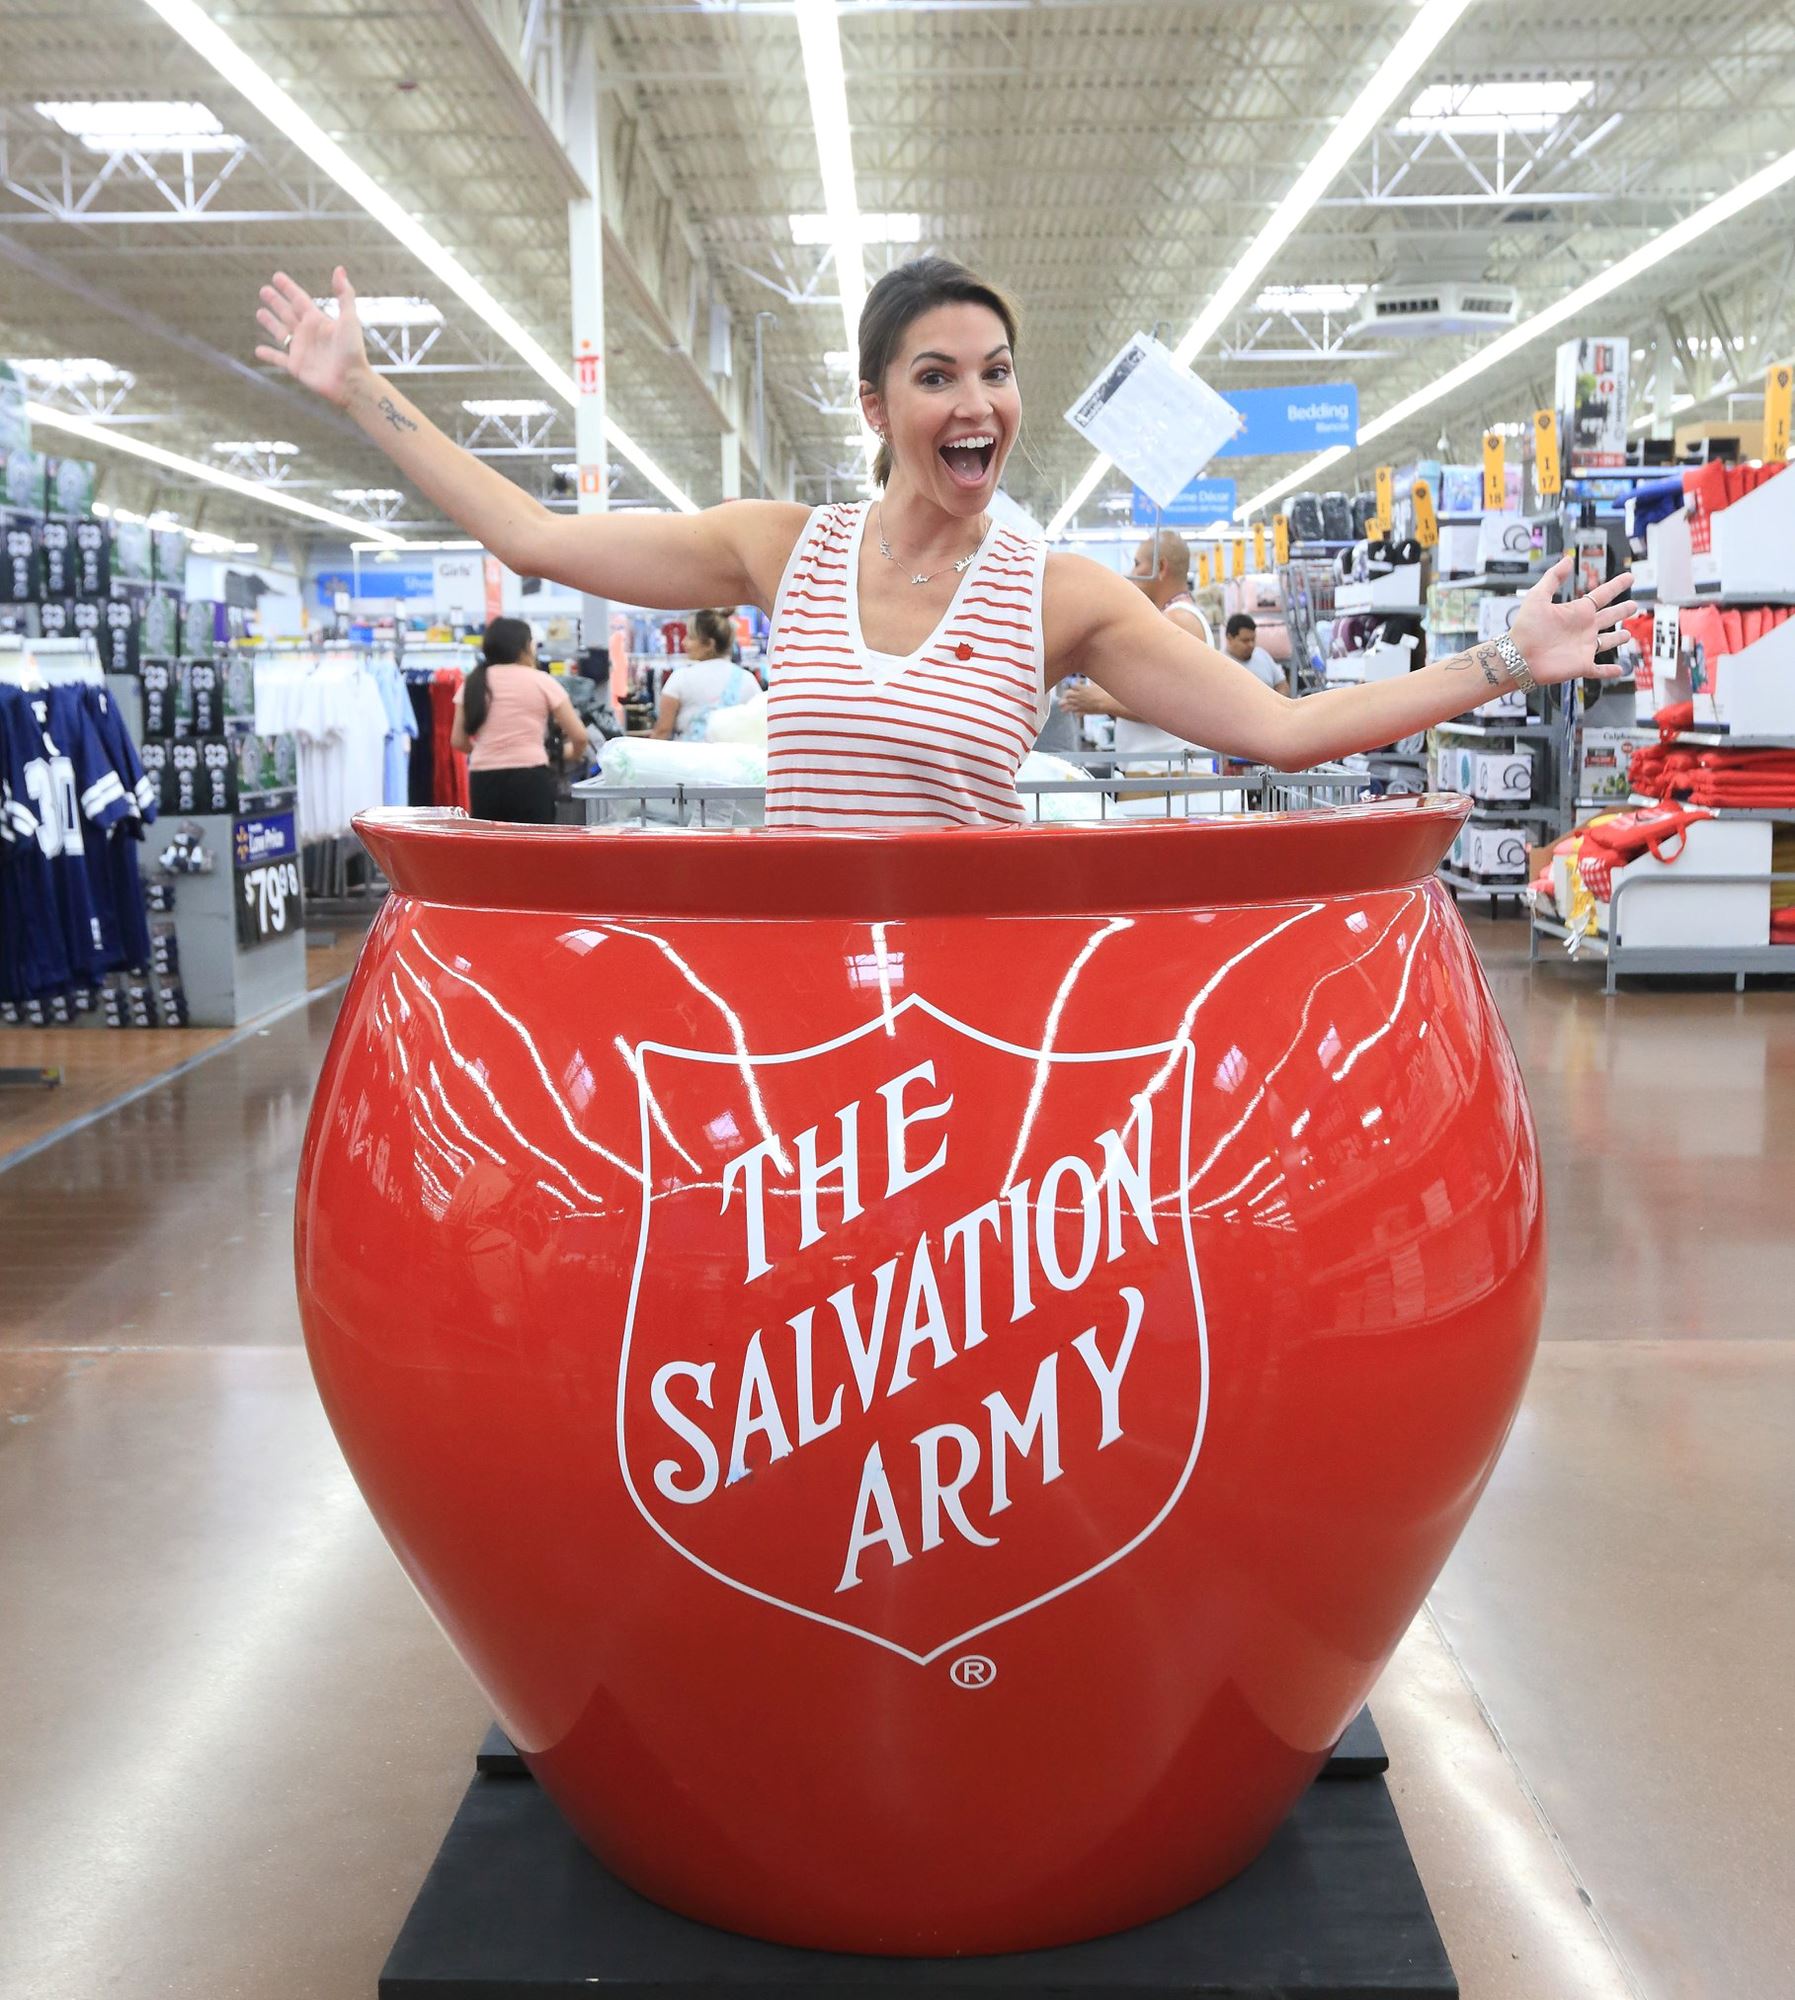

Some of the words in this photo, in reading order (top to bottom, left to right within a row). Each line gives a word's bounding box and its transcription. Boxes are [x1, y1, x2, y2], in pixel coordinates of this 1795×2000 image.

[1287, 402, 1350, 422] Bedding
[1542, 475, 1555, 489] 17
[720, 1059, 954, 1285] THE
[649, 1093, 1159, 1505] SALVATION
[835, 1286, 1145, 1594] ARMY
